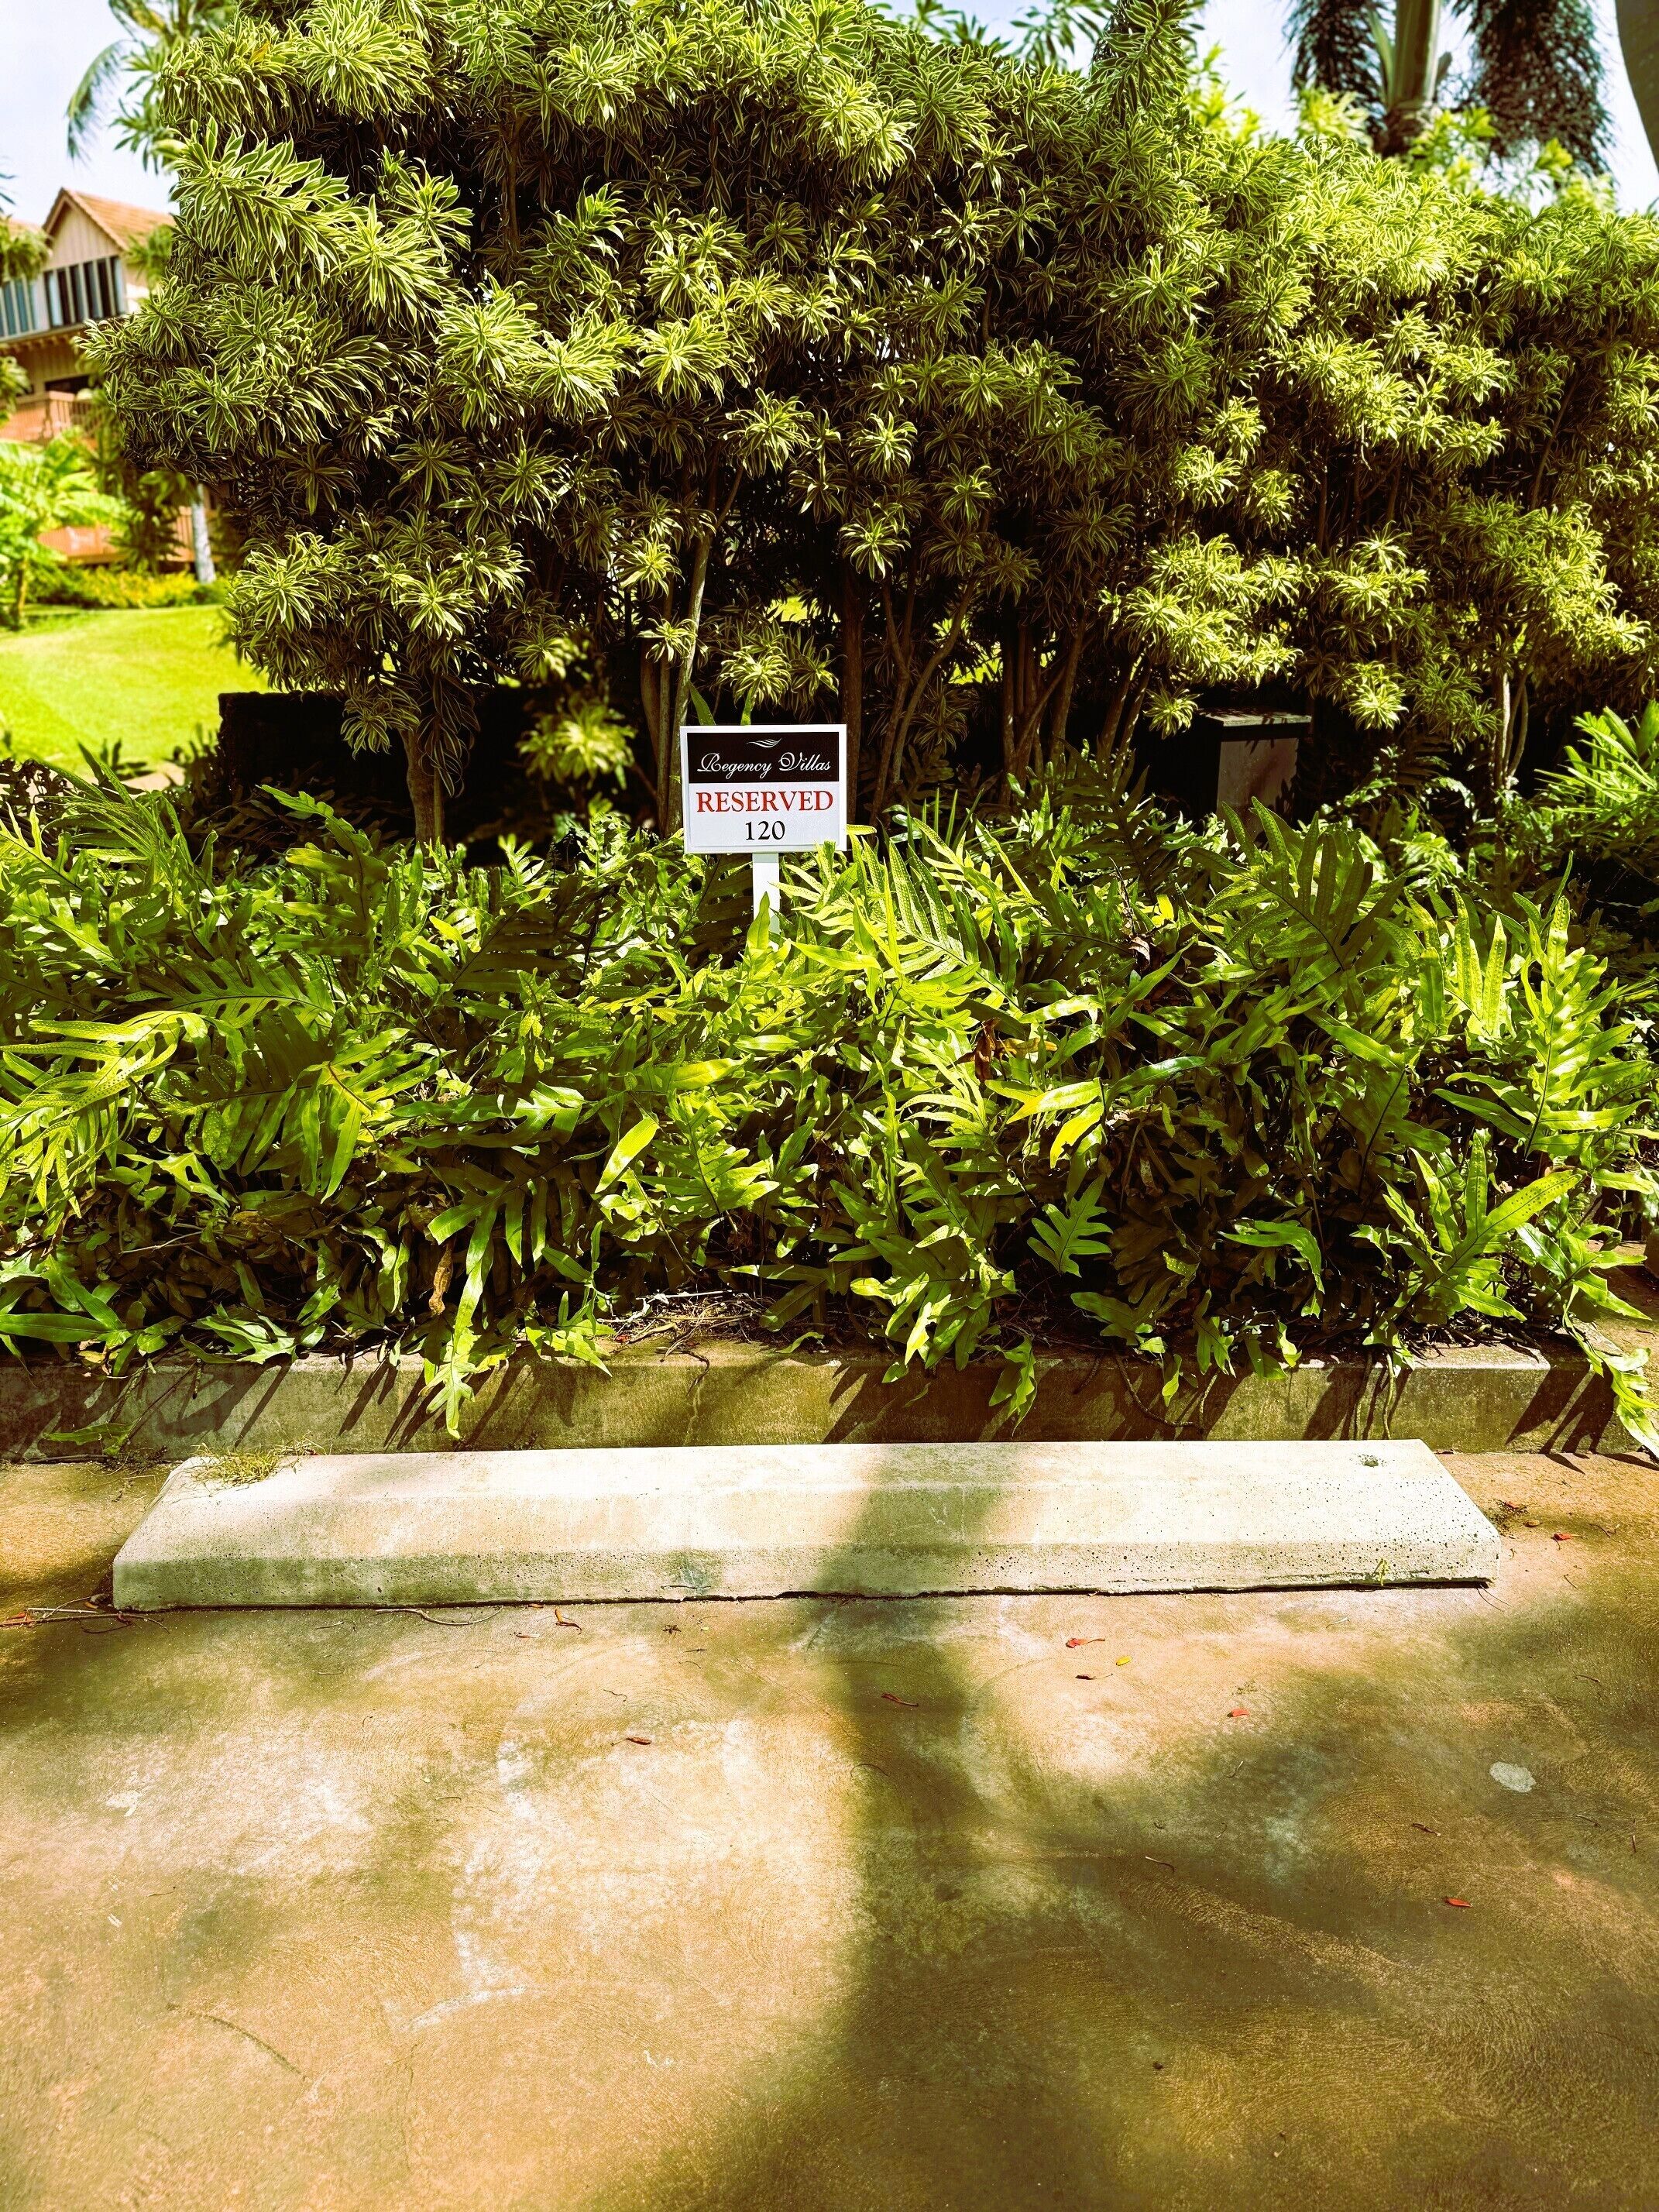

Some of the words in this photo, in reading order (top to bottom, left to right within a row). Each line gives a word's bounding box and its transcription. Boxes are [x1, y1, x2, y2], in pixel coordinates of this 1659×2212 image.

[696, 752, 771, 779] Regency
[778, 752, 831, 771] Villas
[696, 790, 833, 812] RESERVED
[745, 820, 785, 840] 120
